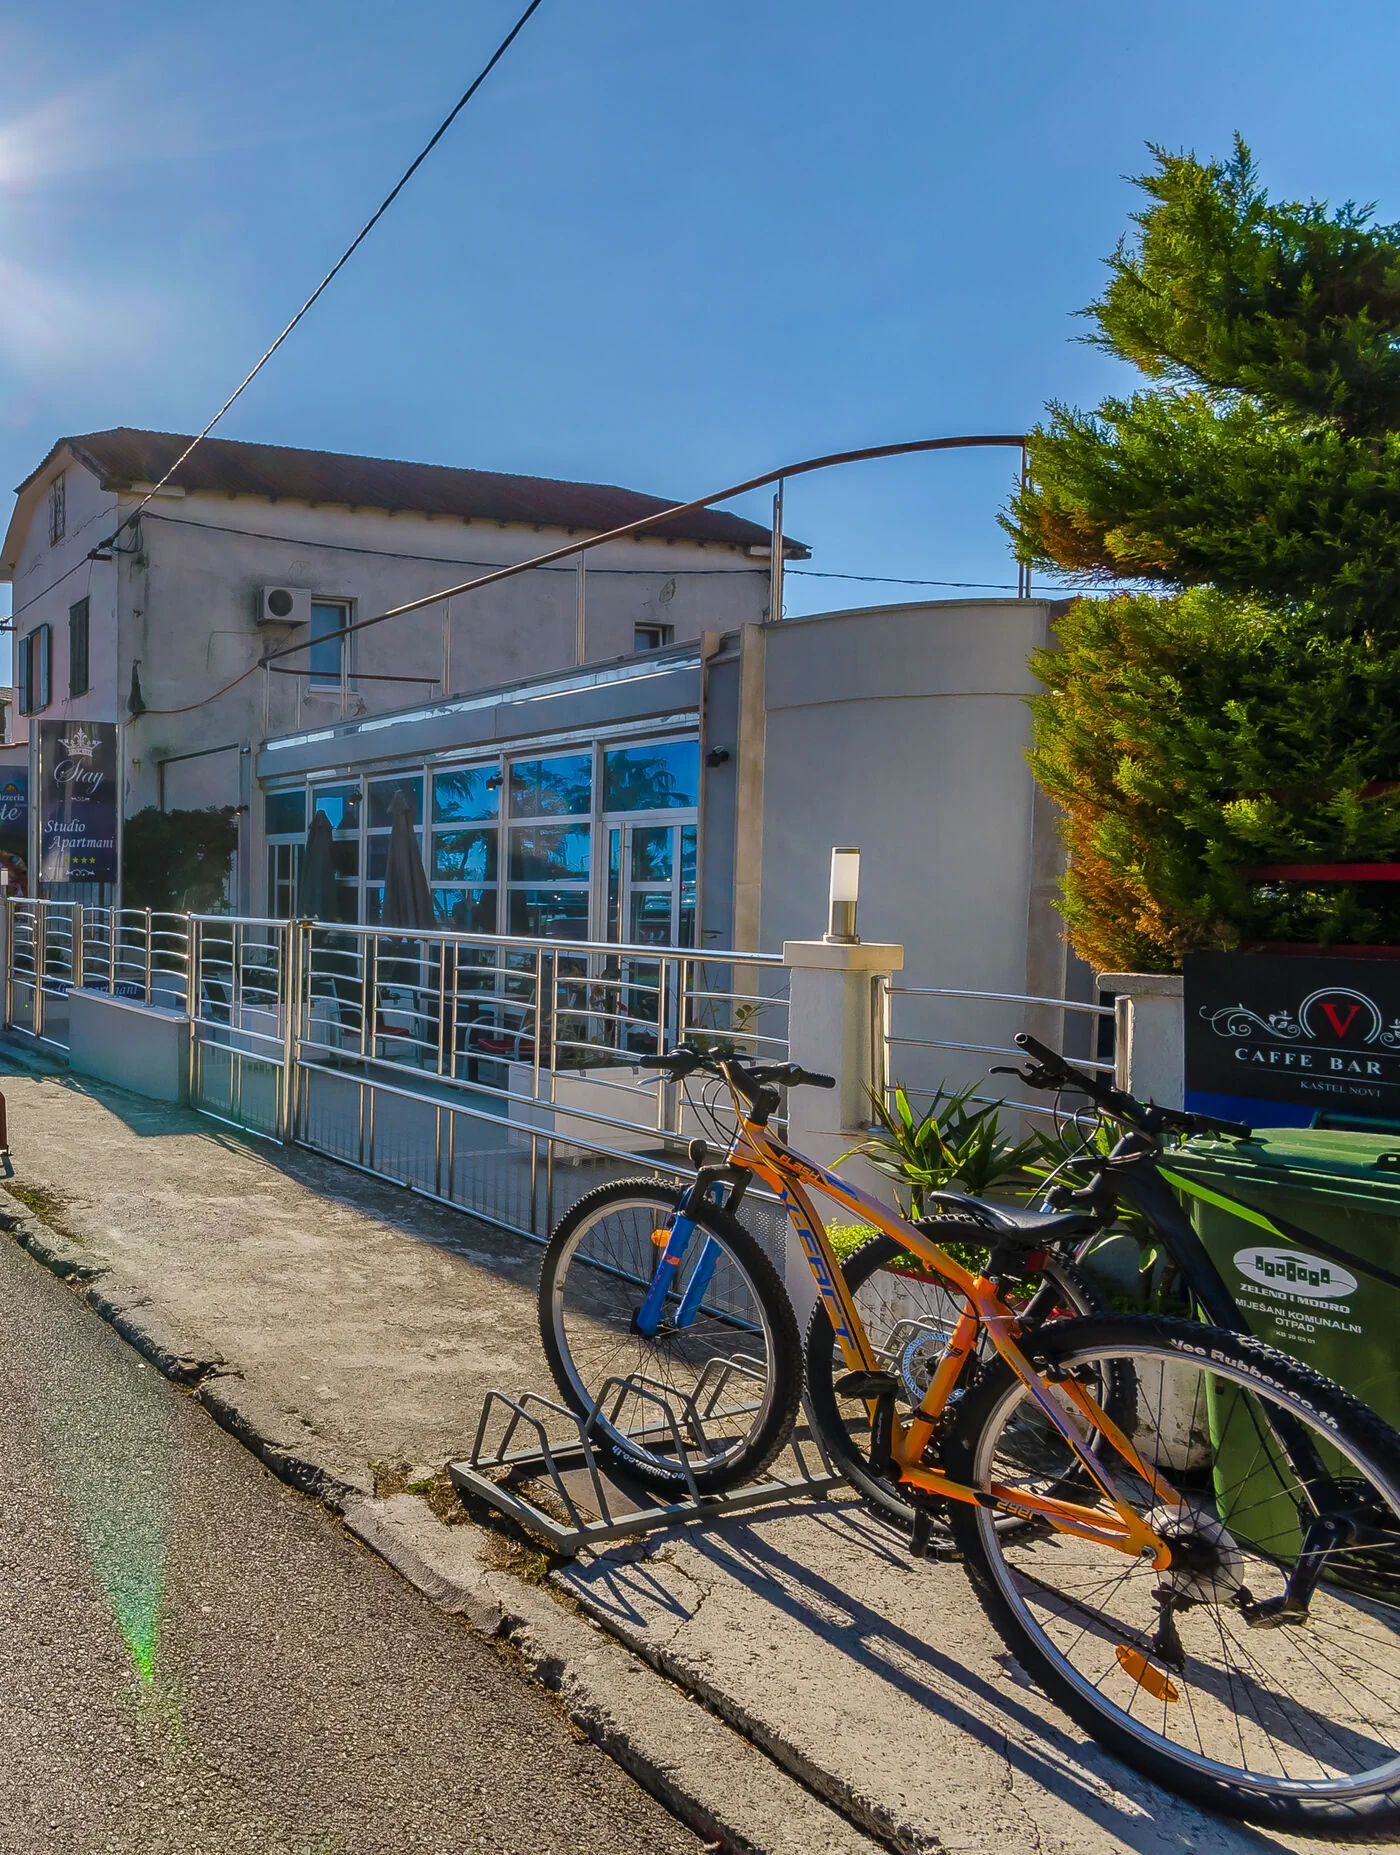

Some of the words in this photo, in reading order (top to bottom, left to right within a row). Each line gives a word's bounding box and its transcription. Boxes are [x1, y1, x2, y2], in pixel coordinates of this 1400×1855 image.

[53, 758, 106, 793] Stay
[44, 818, 86, 834] Studio
[48, 835, 115, 853] Apartmani
[1318, 1003, 1361, 1038] V
[1234, 1047, 1313, 1067] CAFFE
[1330, 1056, 1382, 1075] BAR
[1300, 1080, 1347, 1094] KAŠTEL
[1349, 1086, 1381, 1098] NOVI
[1235, 1297, 1286, 1317] MIJEŠANI
[1288, 1310, 1363, 1334] KOMUNALNI
[1296, 1296, 1351, 1314] MODRO
[1275, 1316, 1316, 1333] OTPAD
[1210, 1349, 1339, 1430] Rubber.co.th
